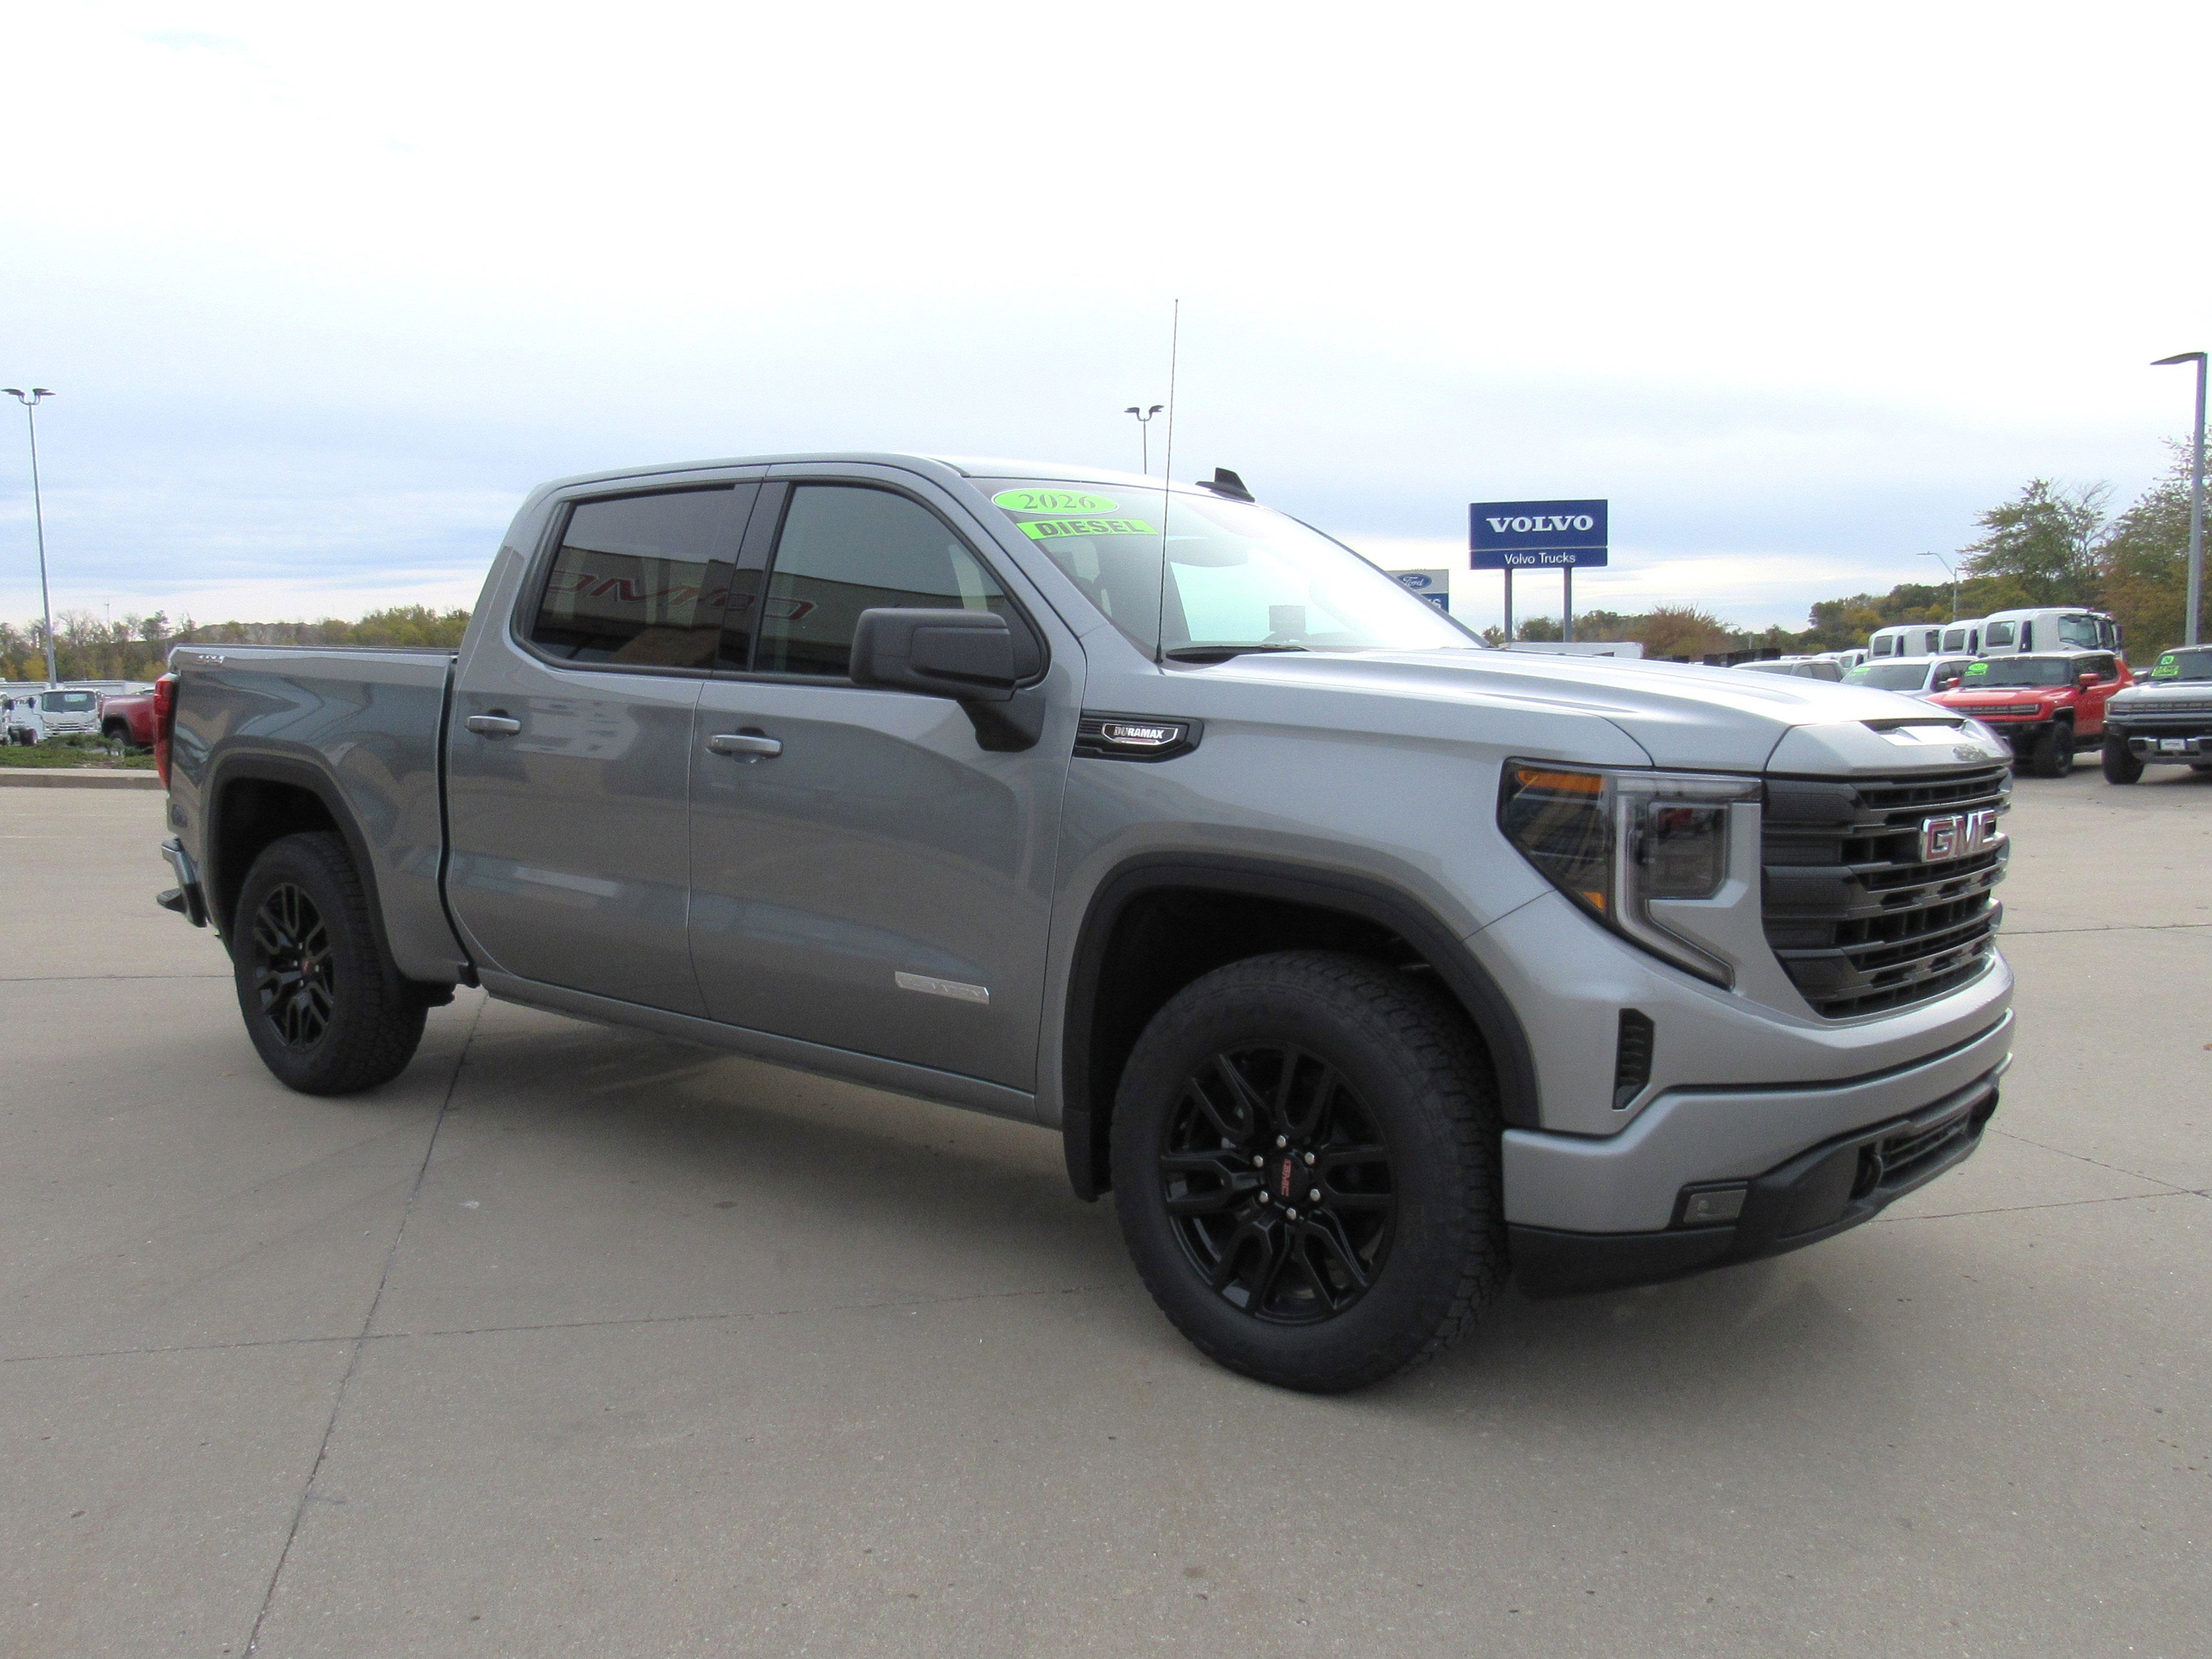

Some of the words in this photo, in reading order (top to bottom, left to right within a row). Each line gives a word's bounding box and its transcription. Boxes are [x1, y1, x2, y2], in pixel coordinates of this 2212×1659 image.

[1018, 493, 1096, 509] 2026
[1034, 520, 1145, 536] DIESEL
[1485, 515, 1593, 533] VOLVO
[1504, 554, 1535, 564] Volvo
[1538, 552, 1576, 564] Trucks
[1403, 576, 1424, 586] Ford
[1113, 726, 1164, 739] DURAMAX
[1921, 810, 2007, 862] GMC
